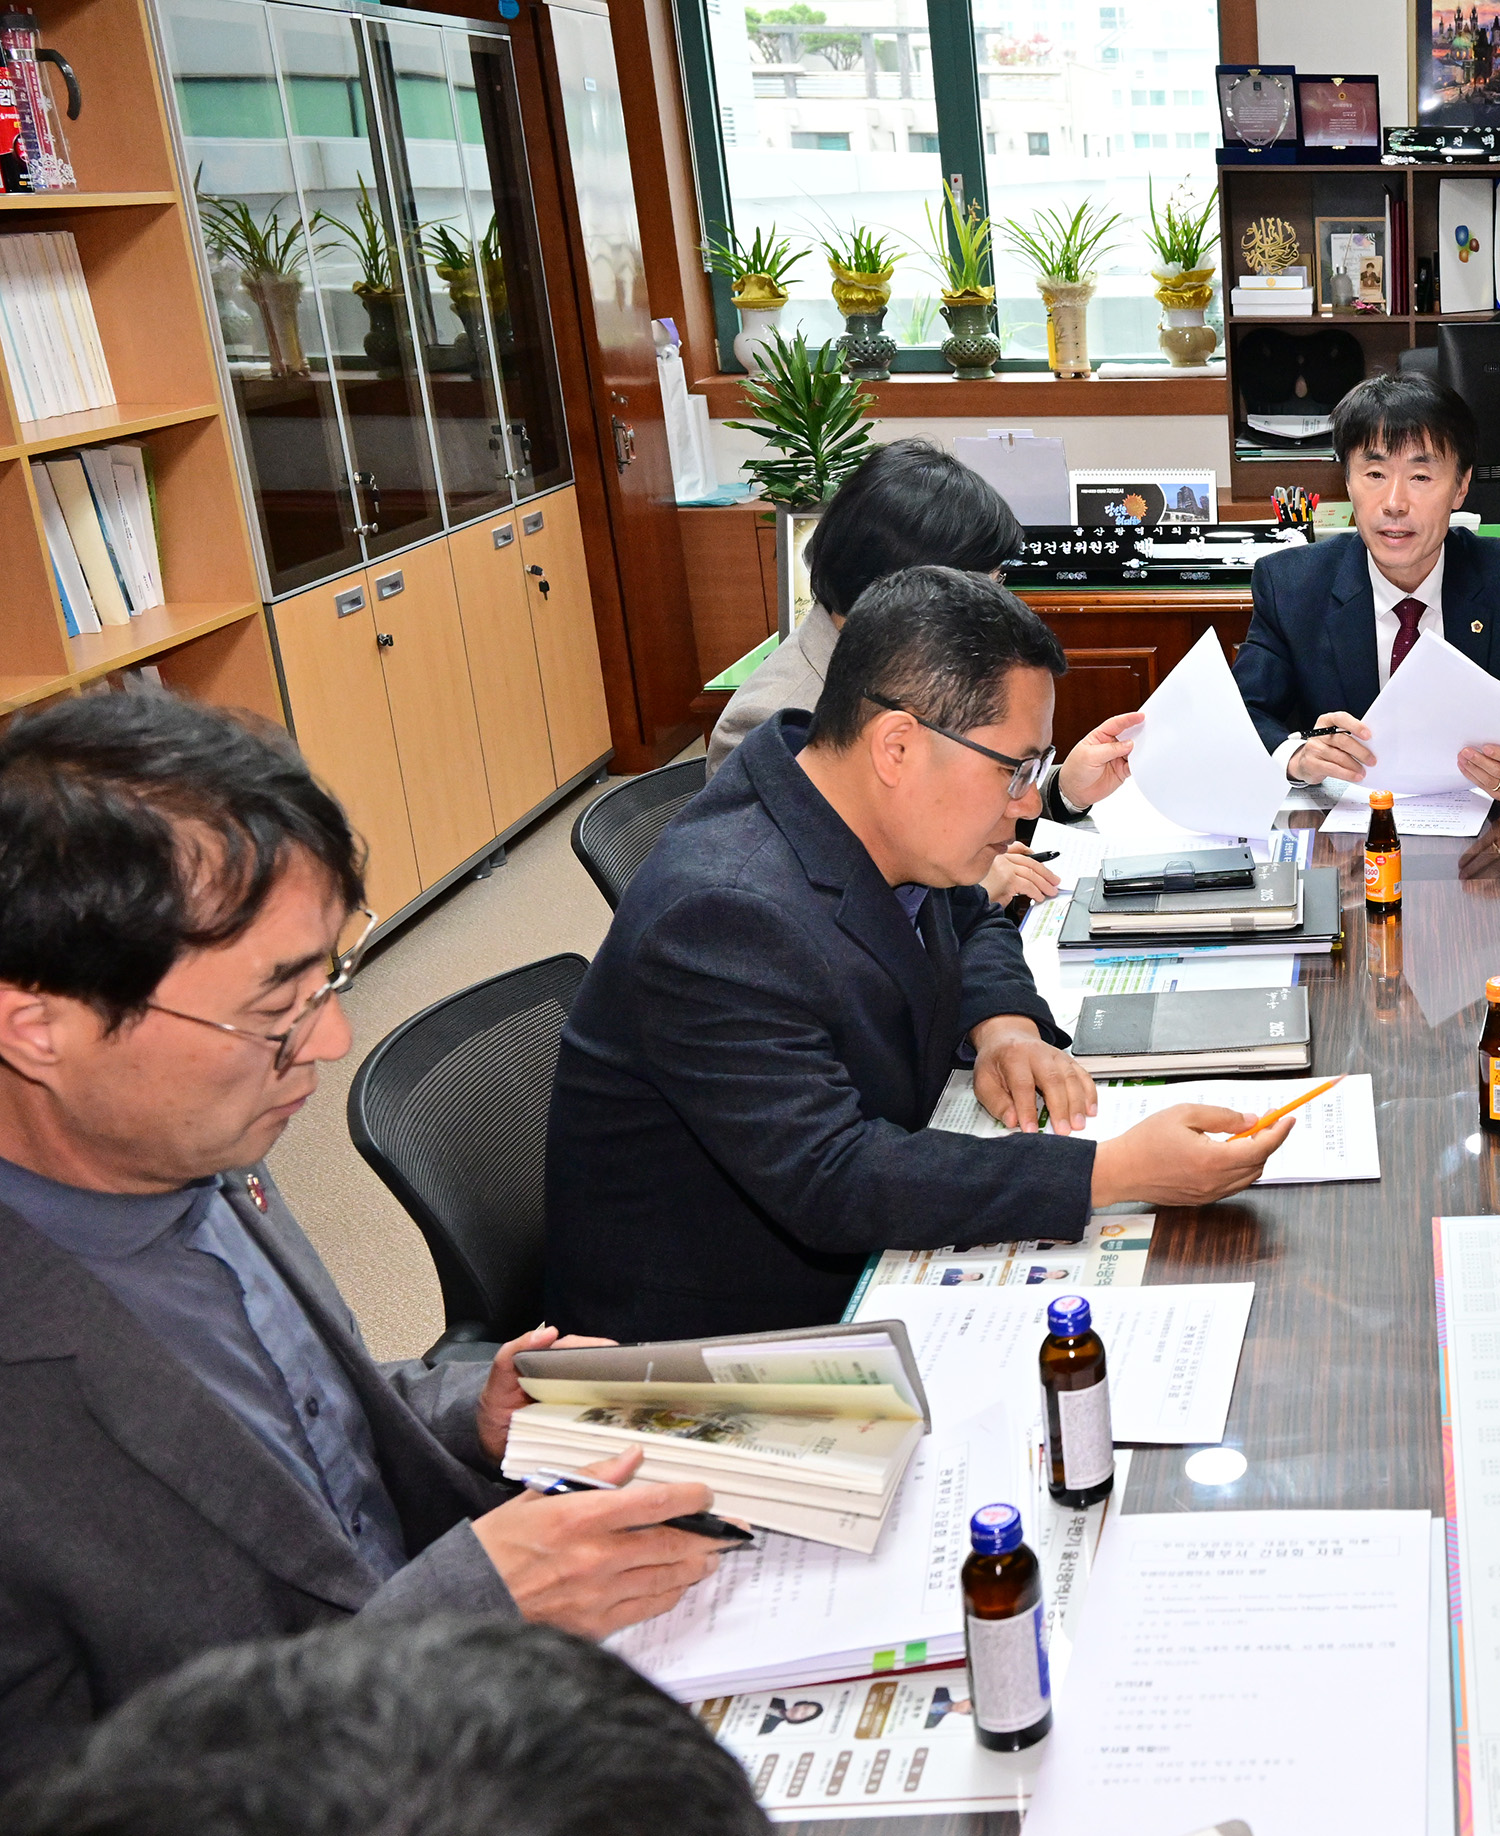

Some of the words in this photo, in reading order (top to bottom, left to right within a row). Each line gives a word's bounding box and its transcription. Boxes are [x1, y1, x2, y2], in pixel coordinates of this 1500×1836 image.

[1260, 889, 1274, 902] 2025
[1269, 1021, 1285, 1037] 2025
[1064, 1516, 1086, 1547] 후반기
